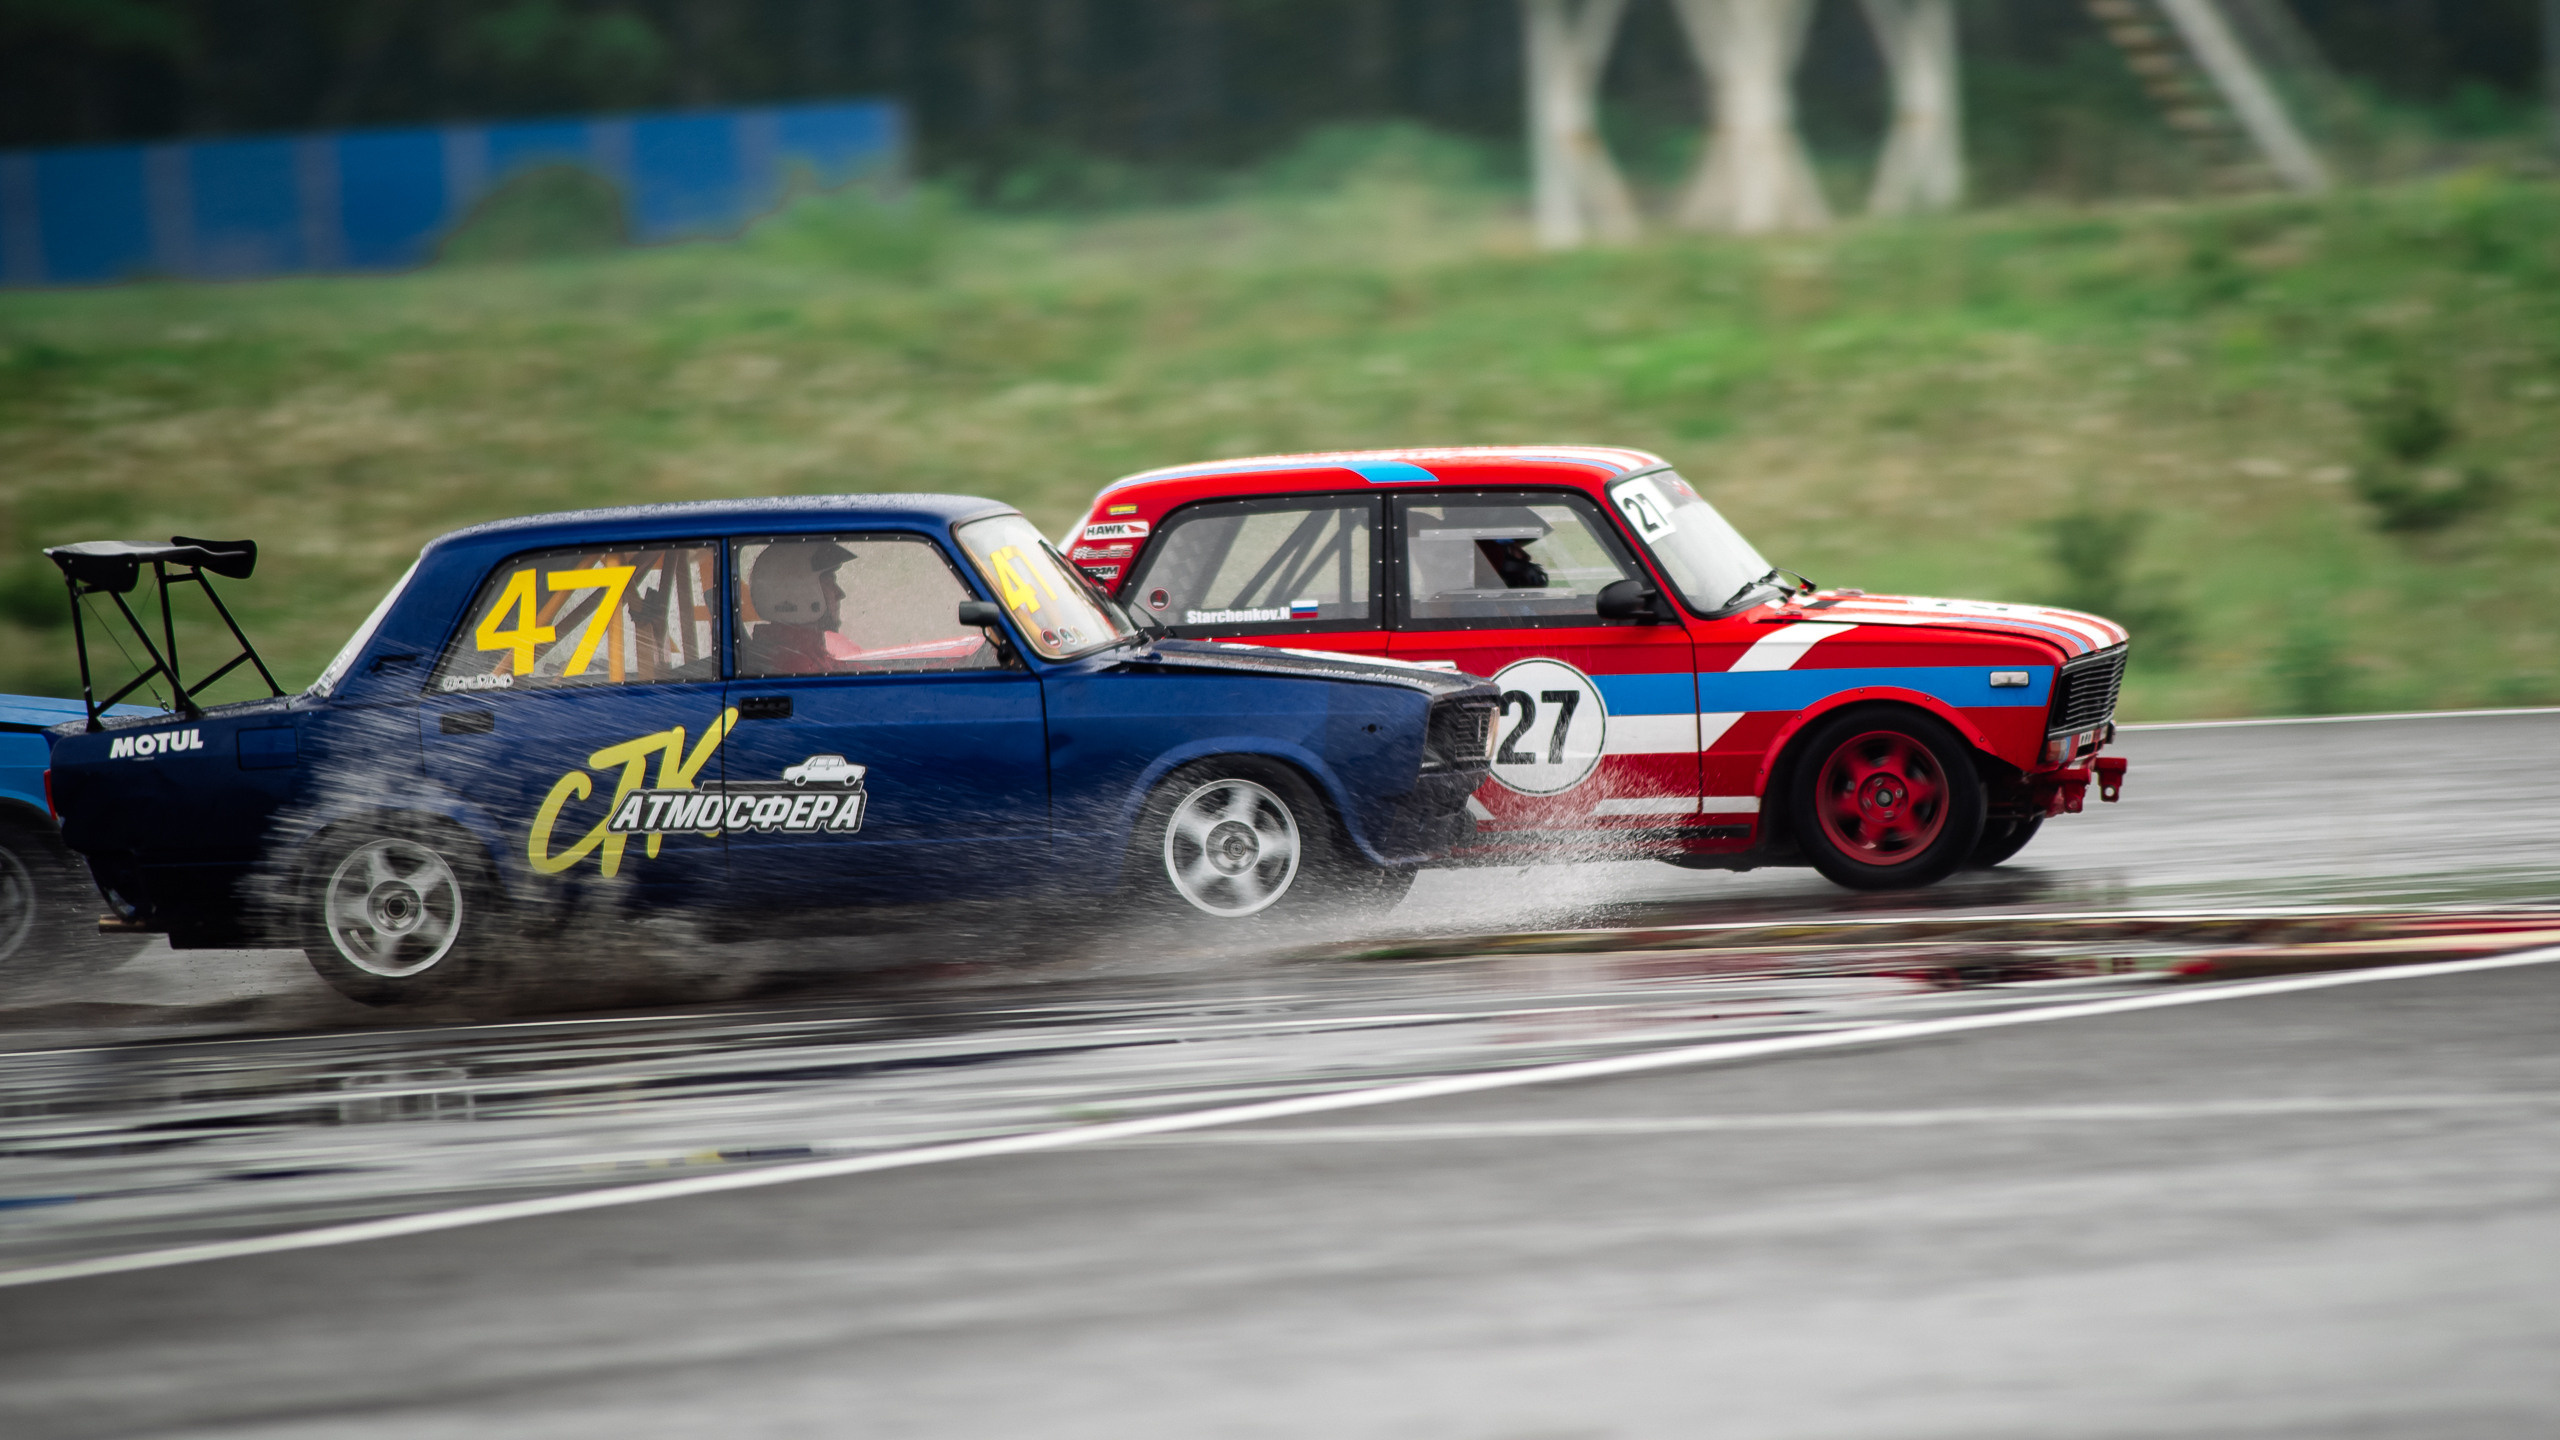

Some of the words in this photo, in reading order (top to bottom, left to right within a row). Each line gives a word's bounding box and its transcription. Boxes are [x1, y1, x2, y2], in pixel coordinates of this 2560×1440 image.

[1086, 525, 1126, 536] HAWK
[1623, 493, 1669, 534] 27
[990, 545, 1058, 614] 47
[476, 566, 636, 677] 47
[1186, 607, 1290, 624] Starchenkov.N
[110, 729, 204, 759] MOTUL
[1496, 690, 1580, 765] 27
[612, 794, 858, 830] АТМОСФЕРА
